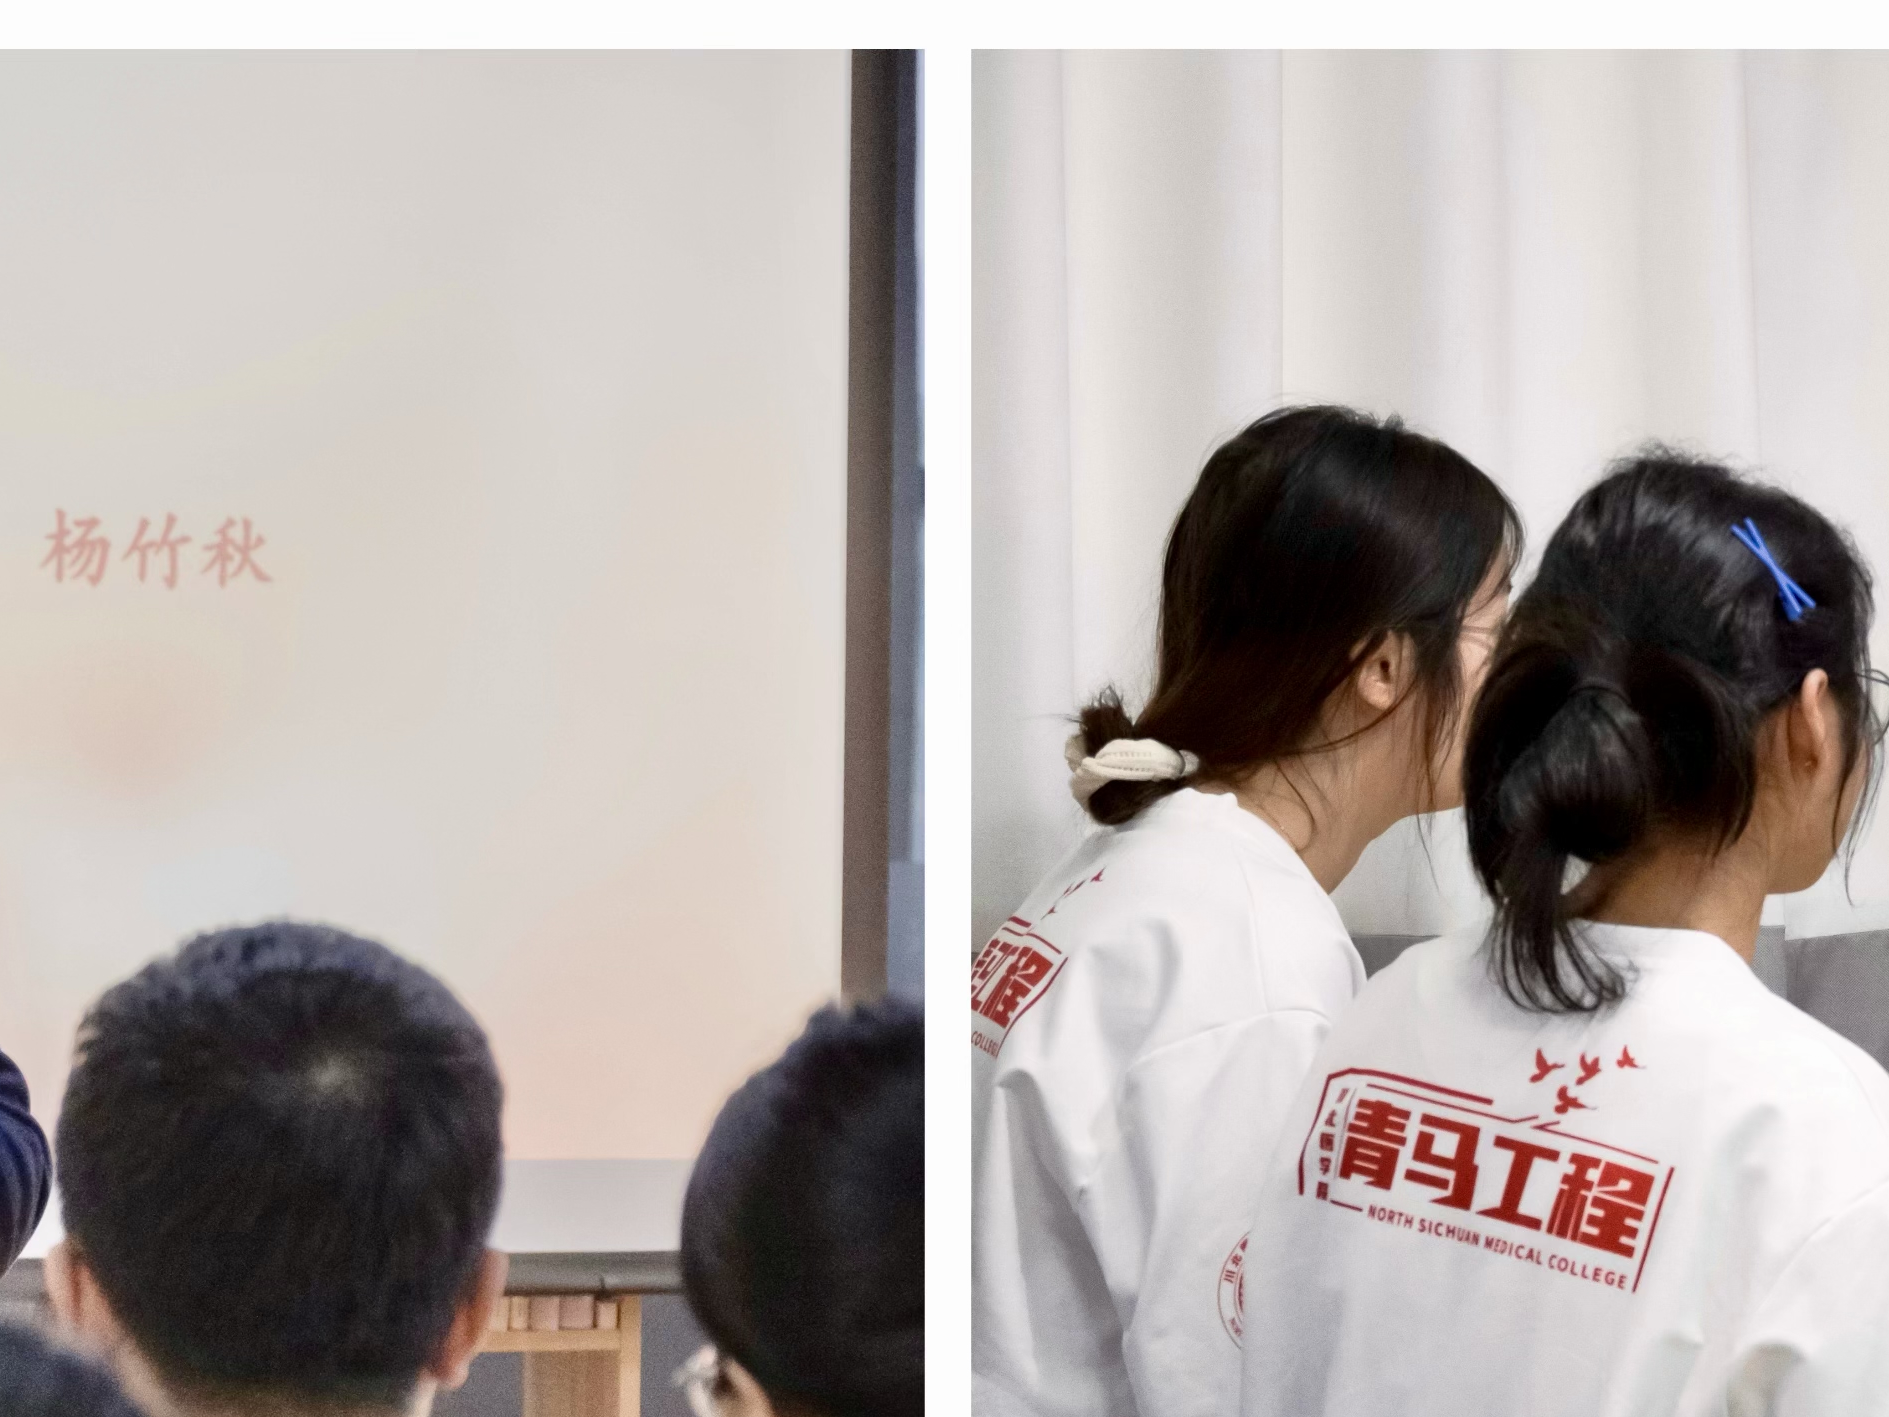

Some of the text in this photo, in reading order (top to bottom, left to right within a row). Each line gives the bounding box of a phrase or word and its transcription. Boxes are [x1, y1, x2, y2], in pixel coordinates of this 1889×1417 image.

[41, 507, 274, 589] 杨竹秋
[1338, 1098, 1656, 1259] 青马工程
[1367, 1204, 1628, 1290] NORTH SICHUAN MEDICAL COLLEGE
